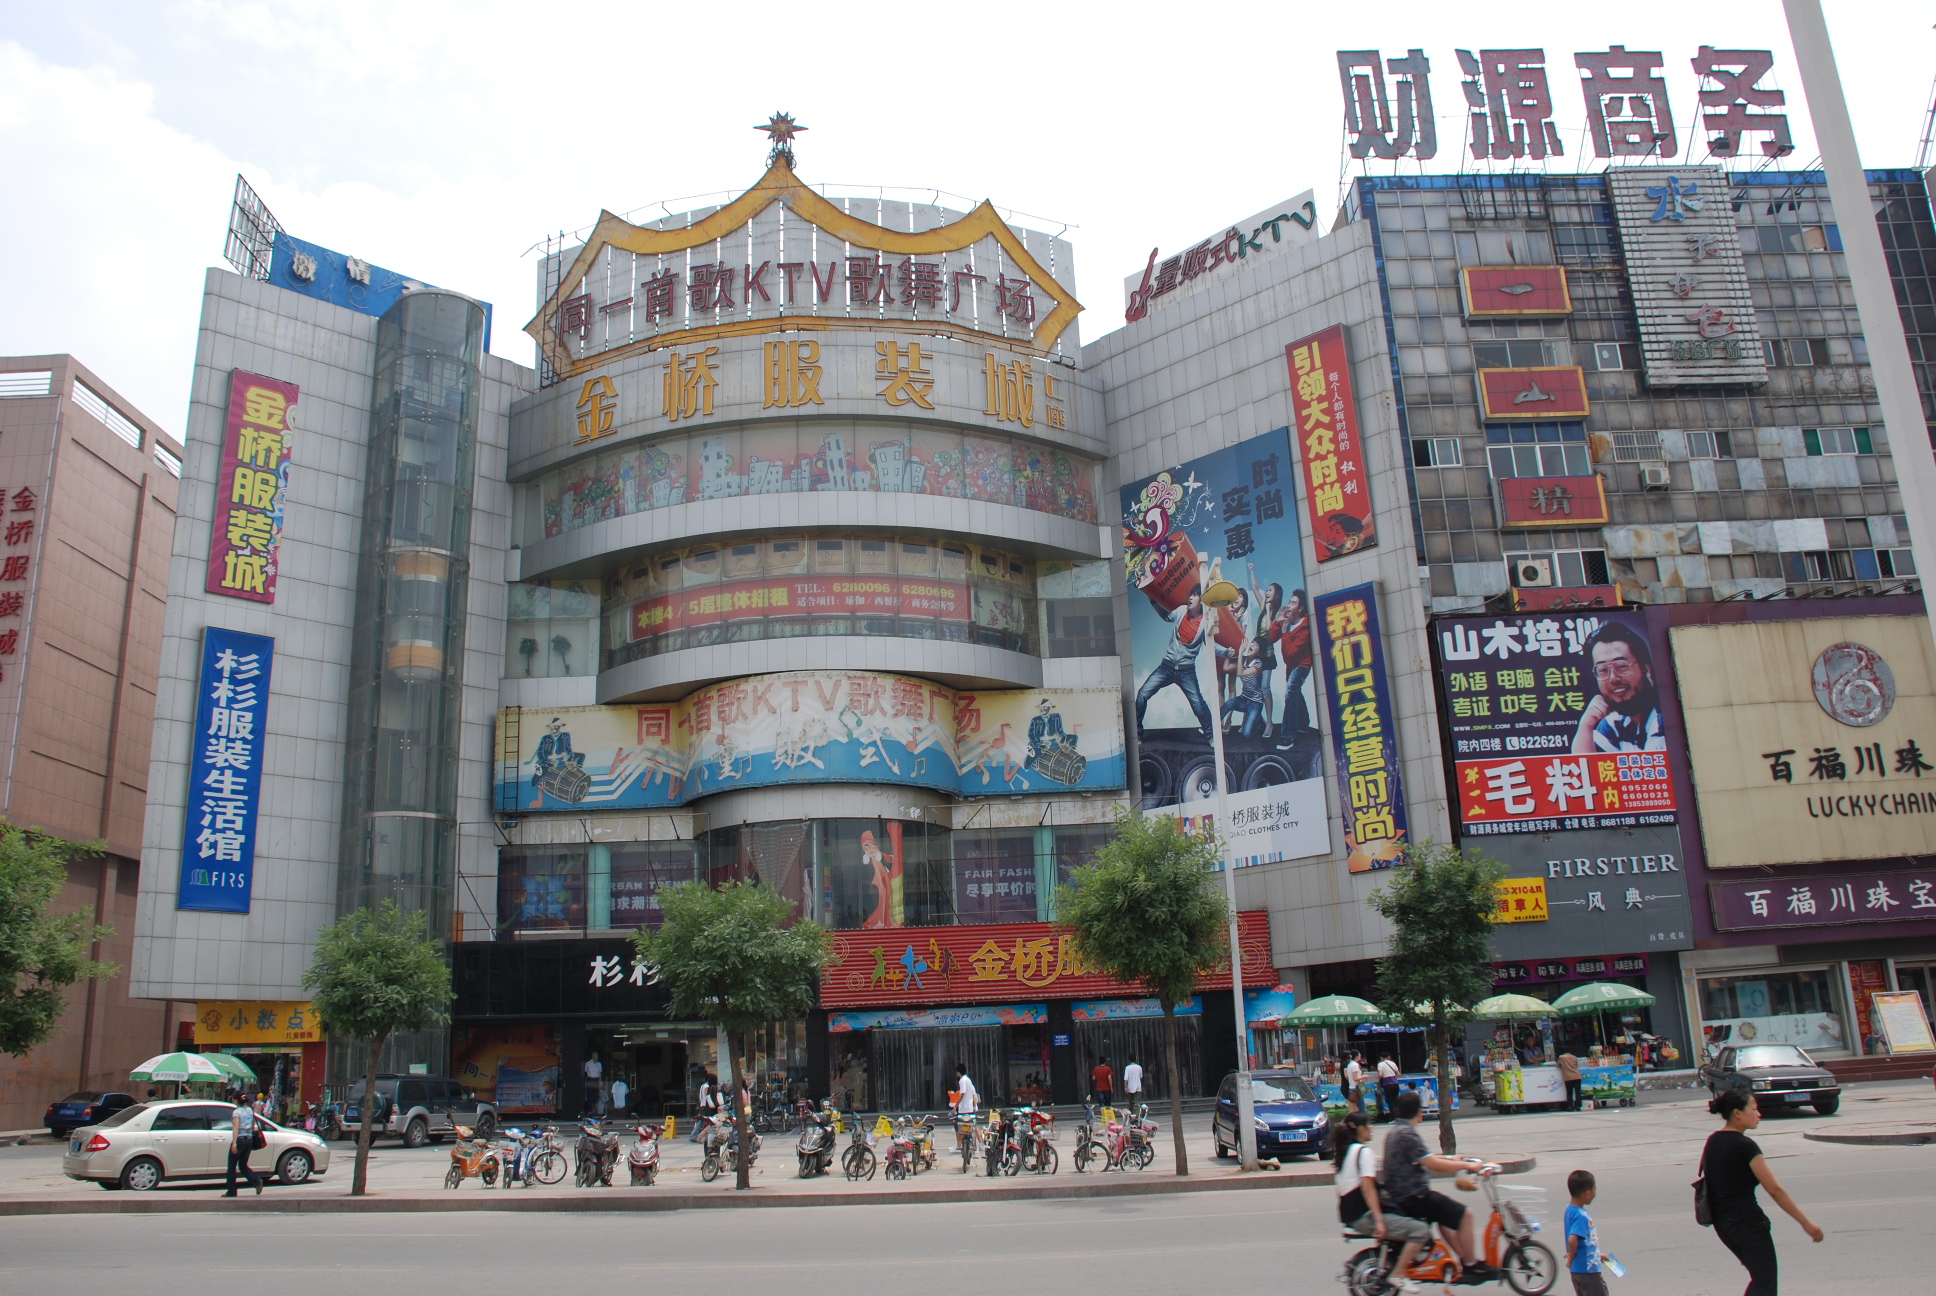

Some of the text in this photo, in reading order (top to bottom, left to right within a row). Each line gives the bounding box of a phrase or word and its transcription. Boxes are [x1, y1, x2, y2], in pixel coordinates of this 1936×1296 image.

[1336, 45, 1793, 160] 财源商务
[1150, 201, 1316, 300] 量贩式KTV
[558, 254, 1036, 347] 同一首歌KTV歌舞广场
[572, 340, 1035, 446] 金桥服装城
[1292, 340, 1345, 517] 引领大众时尚
[1328, 370, 1359, 495] 每个人都有时尚的 权利
[220, 386, 287, 595] 金桥服装城
[1251, 452, 1284, 525] 时尚
[1221, 485, 1256, 561] 实惠
[832, 582, 891, 593] 6280096
[902, 584, 955, 599] 6280696
[1442, 617, 1599, 661] 山木培训
[1450, 666, 1581, 692] 外语 电脑 会计
[1452, 691, 1586, 718] 考证 中专 大专
[1326, 600, 1397, 844] 我们只经营时尚
[195, 648, 262, 862] 杉杉服装生活馆
[1457, 734, 1569, 753] 院内四楼 8226281
[1616, 754, 1666, 768] 服装加工
[1618, 767, 1668, 782] 量体定做
[1483, 757, 1599, 815] 毛料
[1597, 759, 1620, 809] 院内
[1621, 783, 1668, 792] 6952066
[1622, 791, 1669, 800] 6600028
[1218, 800, 1290, 829] 桥服装城
[1248, 824, 1280, 835] CLOTHES
[1283, 821, 1299, 829] CITY
[1600, 816, 1636, 827] 8681188
[1639, 814, 1675, 825] 6162499
[211, 871, 245, 888] FIRS
[964, 869, 993, 879] FAIR
[1546, 853, 1680, 879] FIRSTIER
[1587, 887, 1644, 912] 风典
[1745, 879, 1936, 918] 百福川珠宝
[229, 1007, 305, 1032] 小数点
